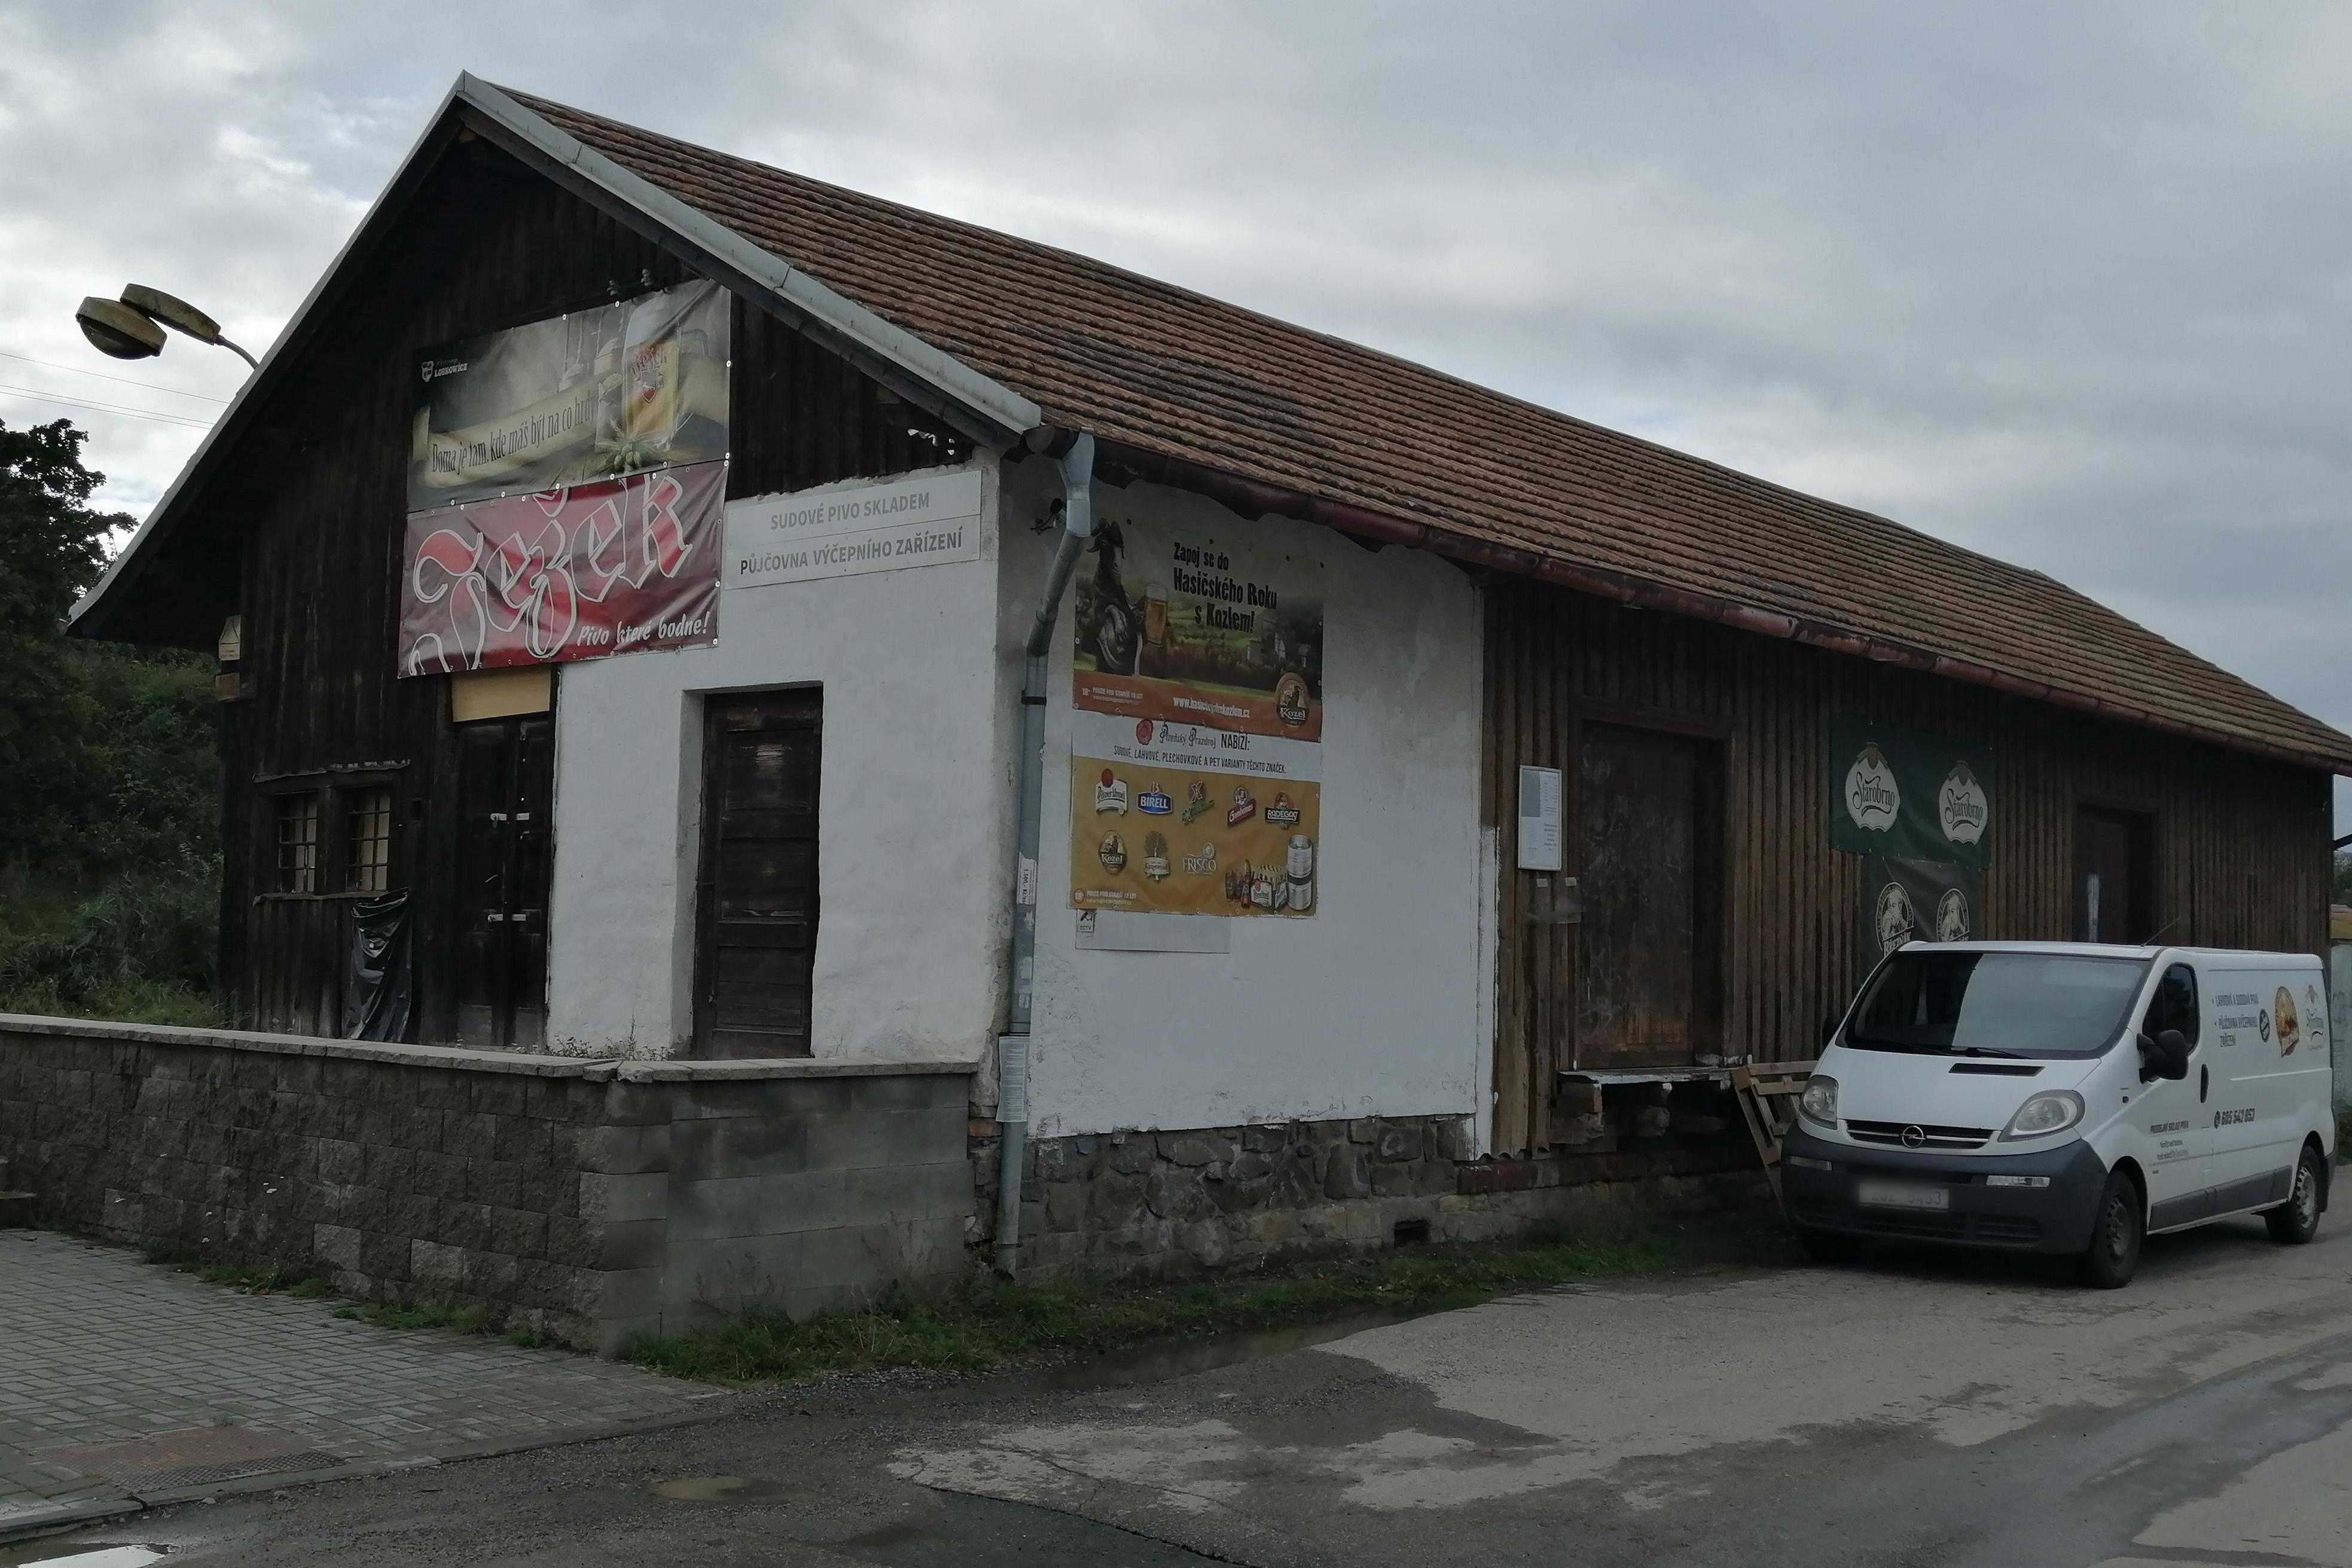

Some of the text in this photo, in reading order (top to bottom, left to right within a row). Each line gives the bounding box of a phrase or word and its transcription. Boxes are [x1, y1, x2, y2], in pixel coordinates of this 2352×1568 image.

[432, 443, 456, 472] Doma
[457, 442, 468, 475] je
[490, 429, 506, 461] kde
[508, 421, 528, 454] máš
[530, 413, 545, 448] být
[548, 412, 559, 438] na
[562, 407, 572, 431] co
[770, 492, 930, 530] SUDOVÉ PIVO SKLADEM
[740, 526, 963, 575] PŮJČOVNA VÝČEPNÍHO ZAŘÍZENÍ
[1174, 541, 1200, 568] Zapoj
[1218, 552, 1229, 571] do
[1173, 567, 1277, 610] Hasičského Roku
[577, 610, 710, 646] Pivo které bodne!
[1195, 602, 1255, 634] s Kozlem!
[1280, 707, 1307, 721] Kozel
[1160, 721, 1250, 751] Plzeňský Prazdroj NABÍZÍ:
[1134, 749, 1161, 762] LAHVOVÉ,
[1163, 752, 1202, 766] PLECHOVKOVÉ
[1204, 756, 1209, 767] A
[1210, 757, 1221, 767] PET
[1221, 758, 1246, 770] VARIANTY
[1247, 759, 1265, 771] TĚCHTO
[1266, 761, 1287, 774] ZNAČEK:
[1140, 796, 1169, 809] BIRELL
[1853, 771, 1895, 810] Starobrno
[1945, 788, 1984, 825] Starobrno
[1100, 853, 1123, 864] Kozel
[1182, 857, 1217, 874] FRISCO
